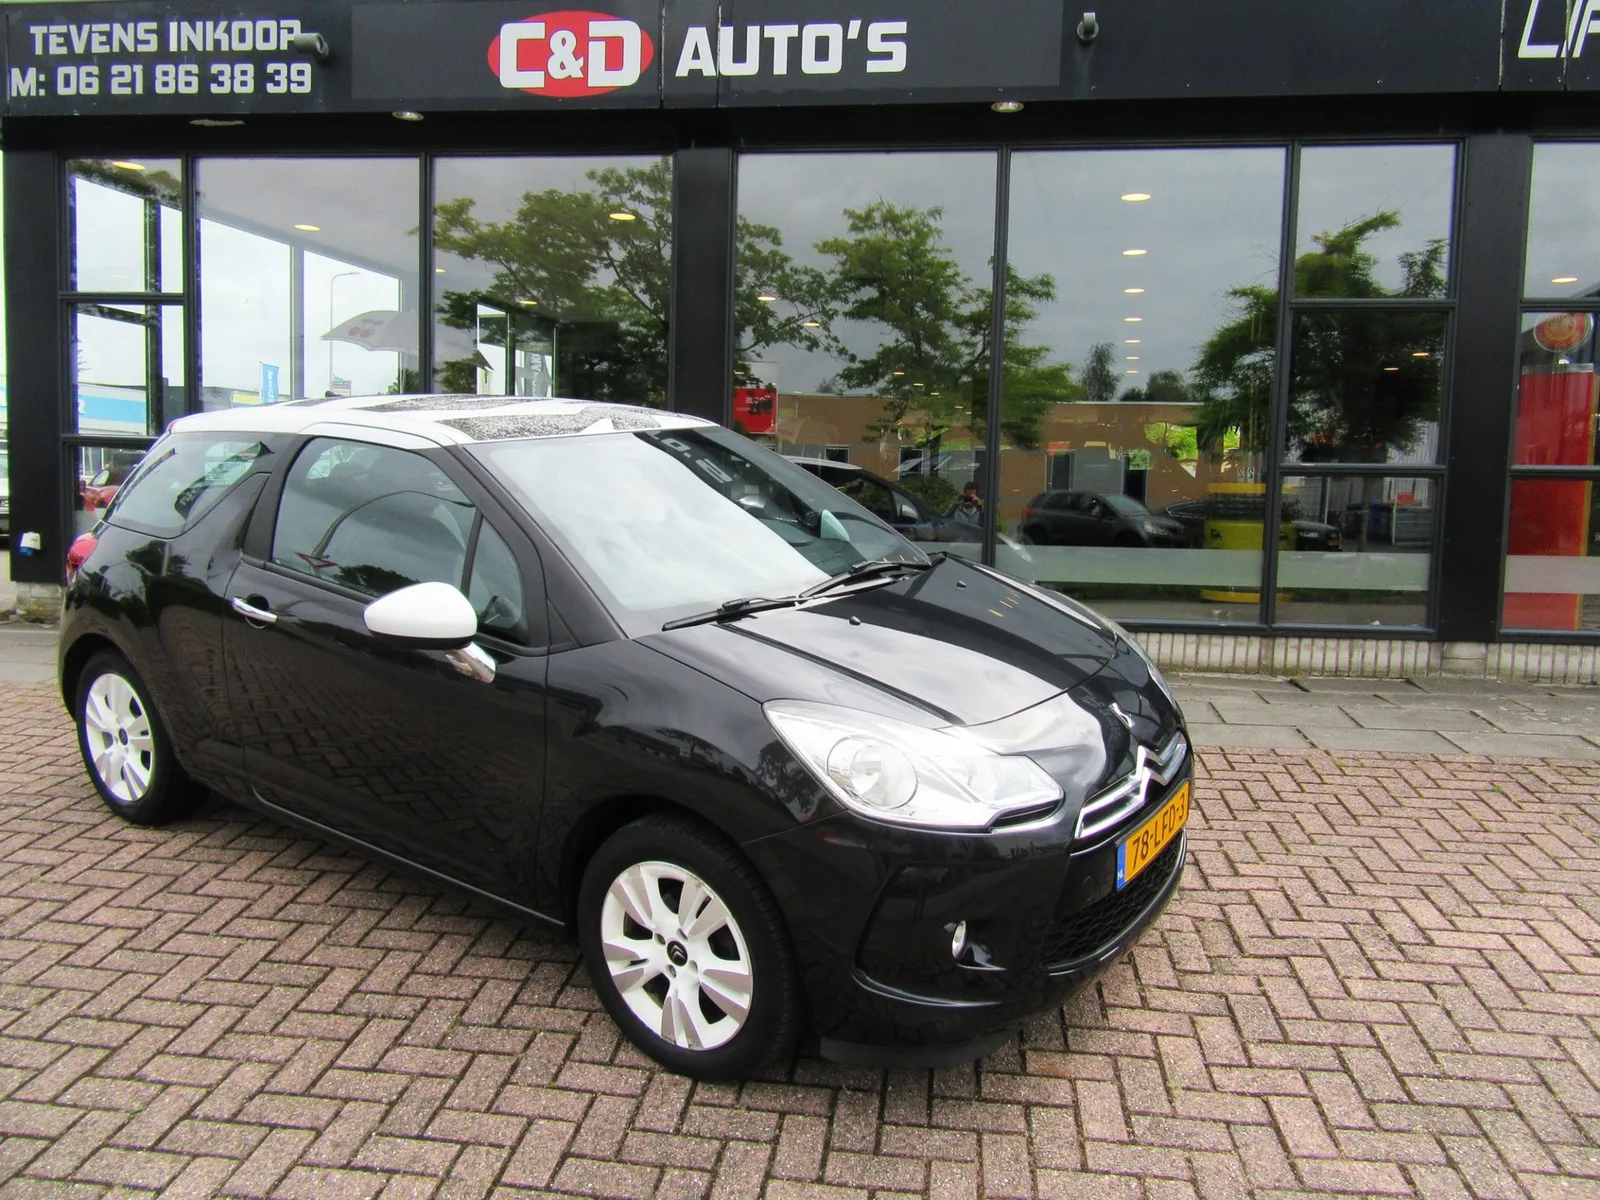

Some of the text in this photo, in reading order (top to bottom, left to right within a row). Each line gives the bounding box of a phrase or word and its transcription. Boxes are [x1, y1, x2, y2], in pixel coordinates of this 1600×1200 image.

[29, 19, 302, 55] TEVENS INKOOP
[500, 19, 908, 89] C&D AUTO'S
[10, 62, 312, 97] M: 06 21 86 38 39
